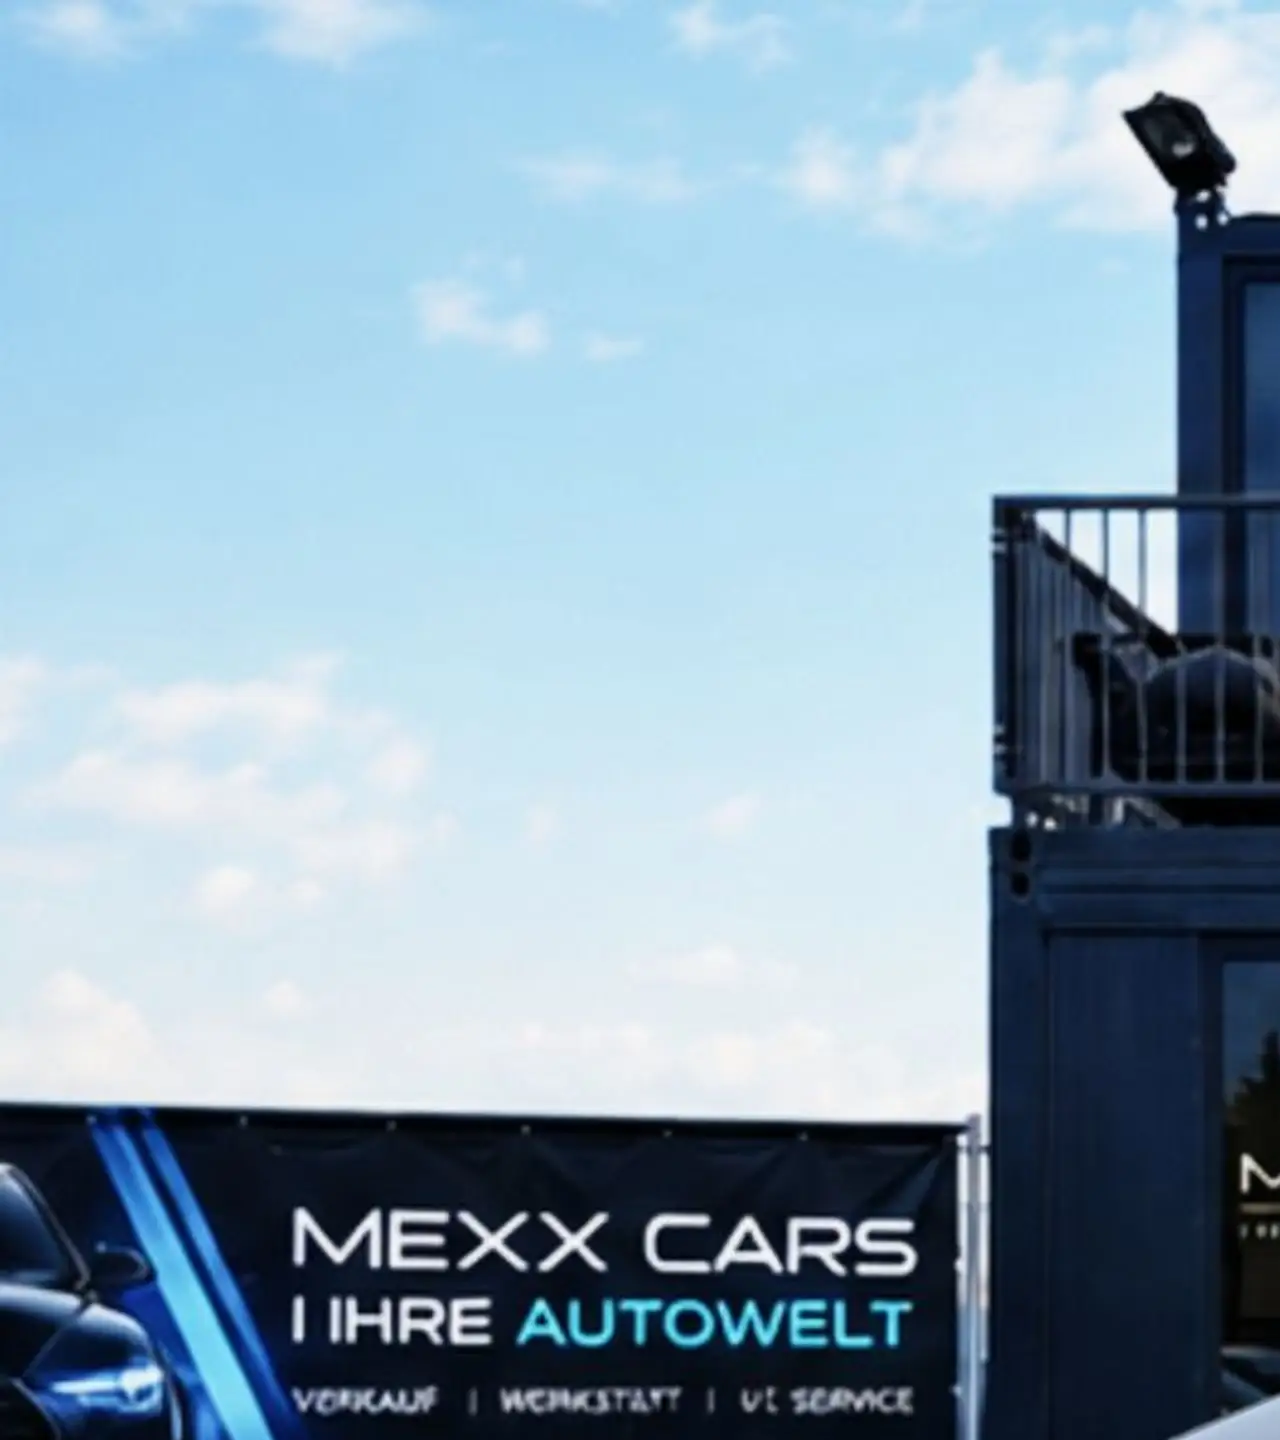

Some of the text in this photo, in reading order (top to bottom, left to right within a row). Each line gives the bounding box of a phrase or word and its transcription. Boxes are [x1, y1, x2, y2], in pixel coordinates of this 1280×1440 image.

[292, 1207, 918, 1277] MEXX CARS
[329, 1296, 492, 1345] IHRE
[516, 1298, 913, 1349] AUTOWELT
